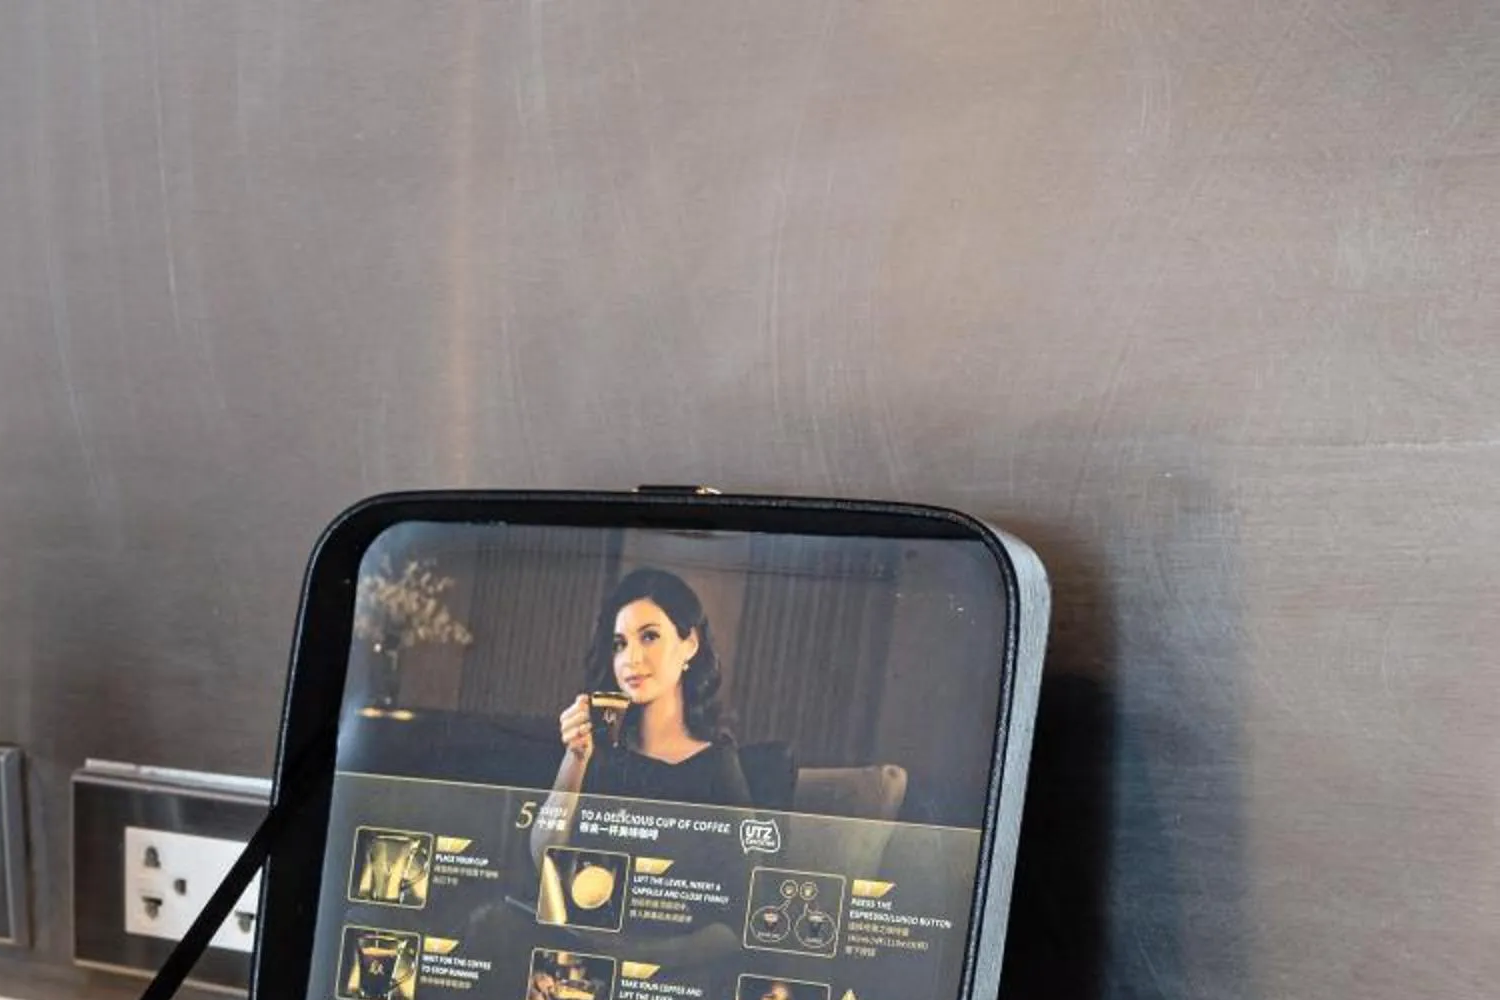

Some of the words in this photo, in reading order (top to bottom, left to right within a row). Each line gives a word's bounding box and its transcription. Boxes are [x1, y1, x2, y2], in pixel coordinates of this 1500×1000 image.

[515, 801, 538, 829] 5
[581, 809, 595, 821] TO
[595, 811, 603, 822] A
[604, 811, 655, 827] DELICIOUS
[656, 816, 677, 829] CUP
[678, 819, 692, 830] OF
[693, 820, 731, 834] COFFEE
[745, 825, 773, 840] UTZ
